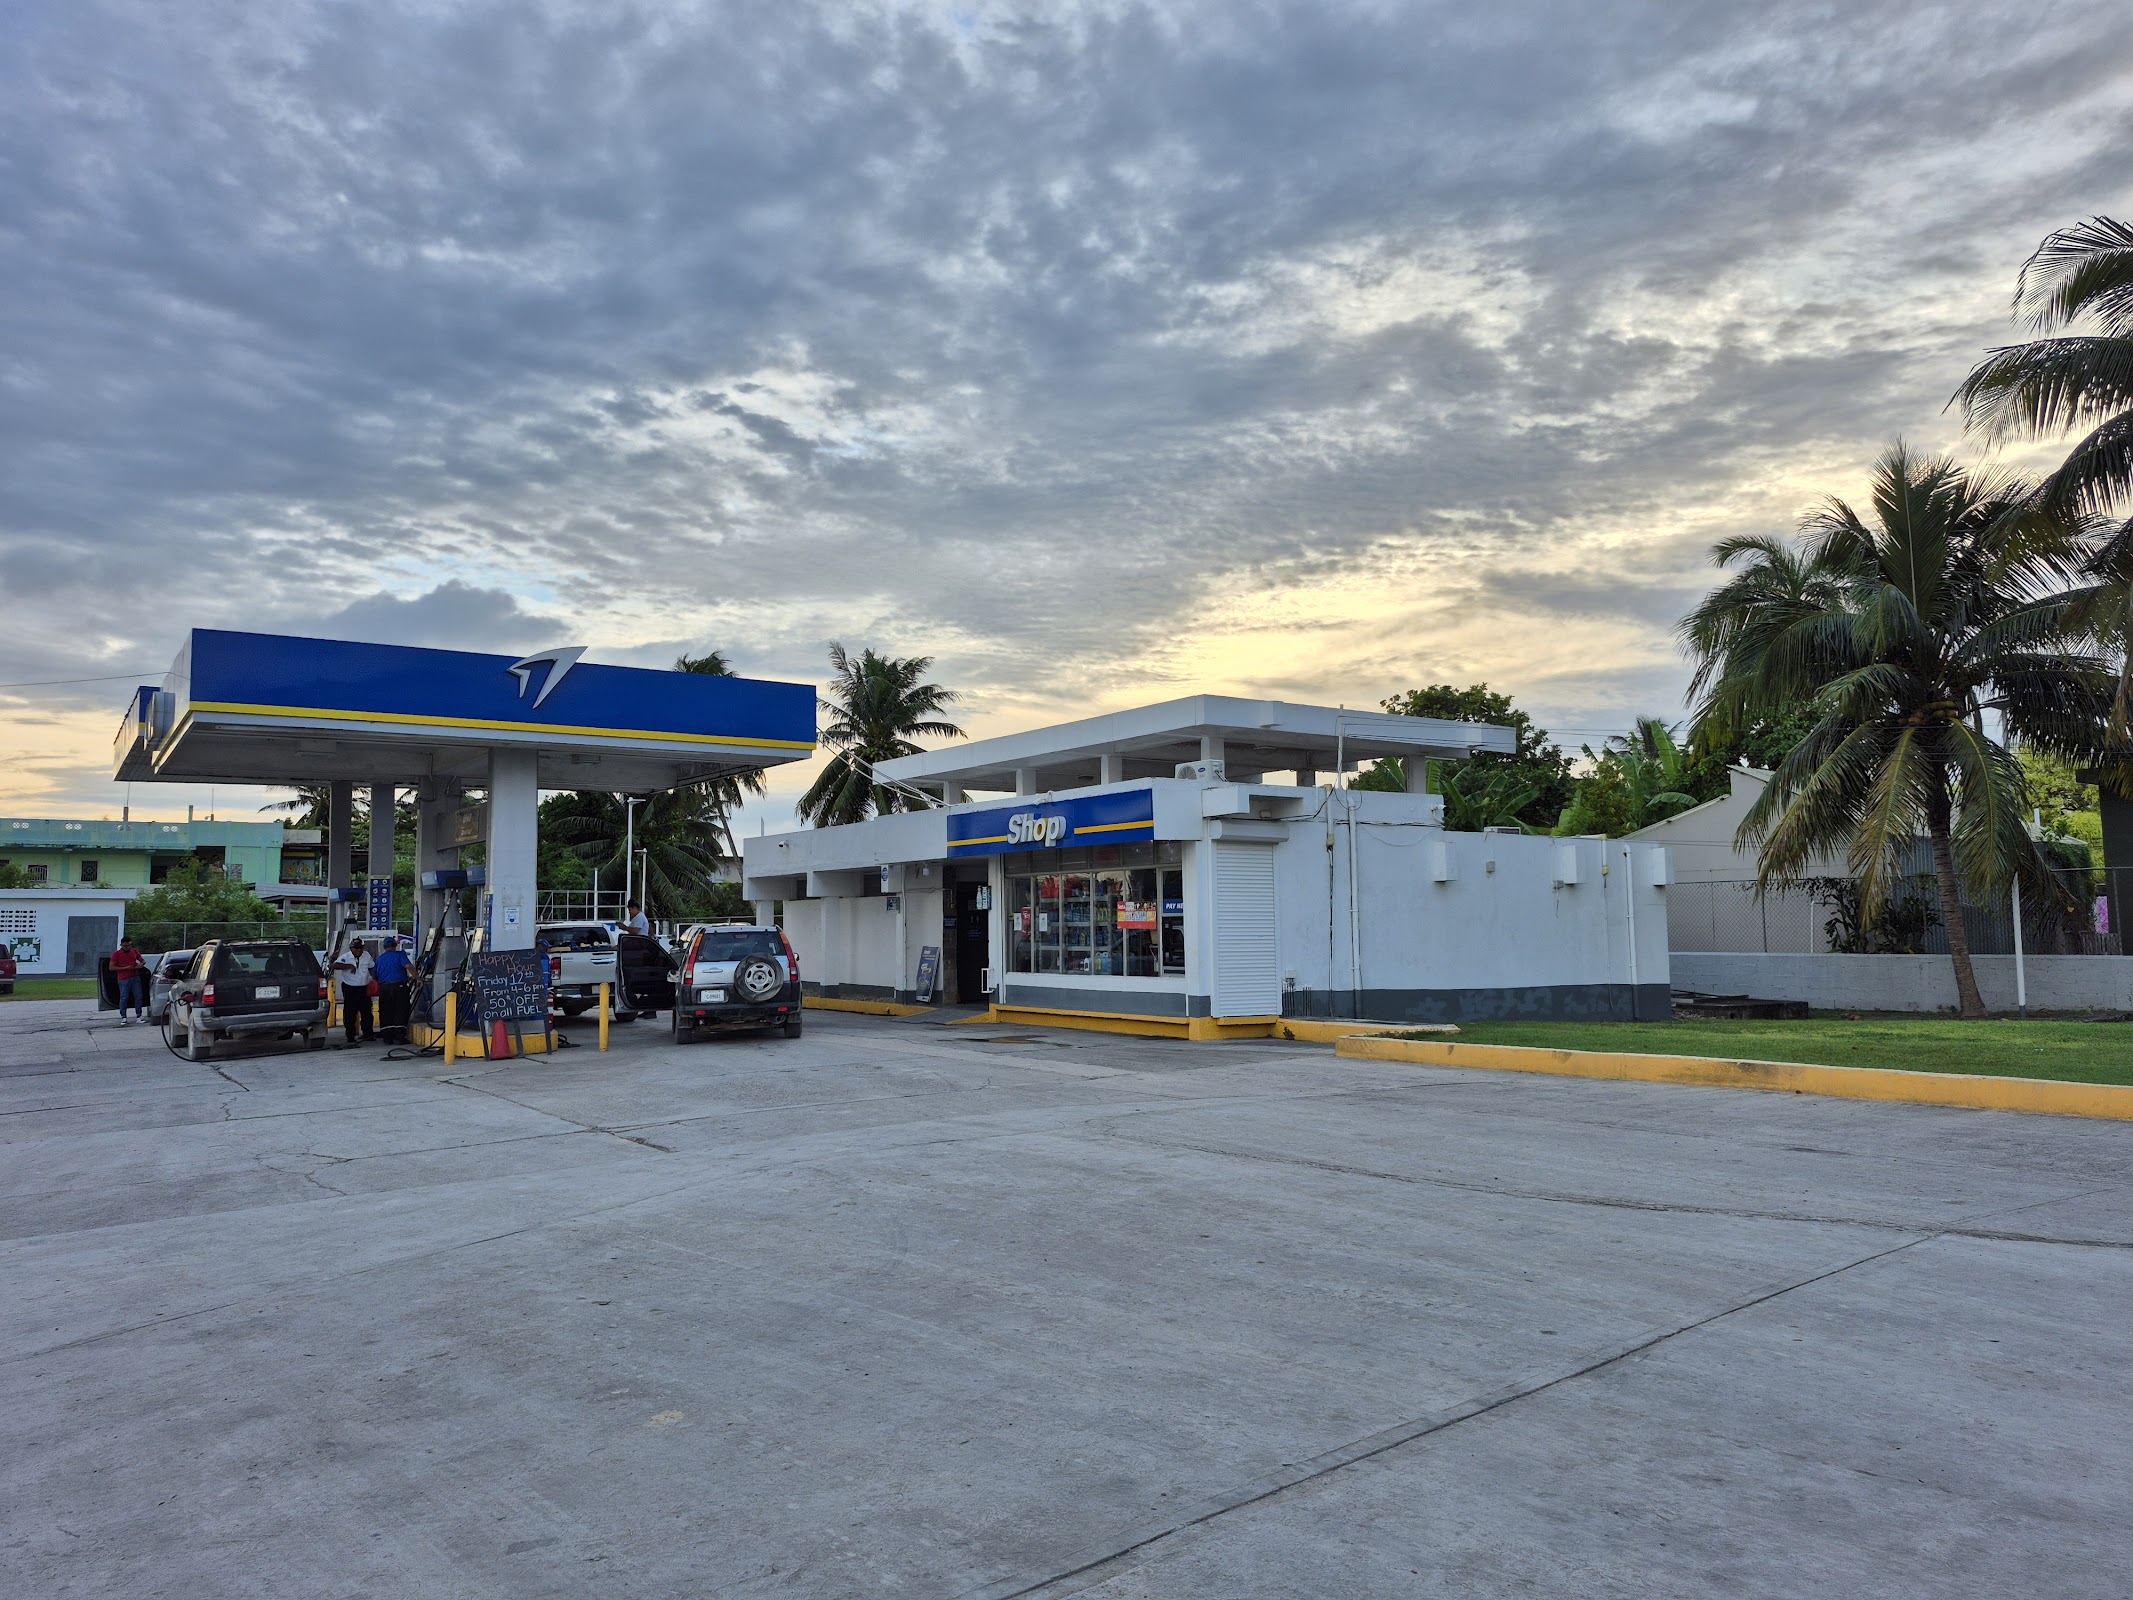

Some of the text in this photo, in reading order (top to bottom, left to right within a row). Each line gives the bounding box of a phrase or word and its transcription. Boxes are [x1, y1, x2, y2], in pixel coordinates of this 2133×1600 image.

[1007, 813, 1067, 847] Shop
[1165, 902, 1176, 910] PAY
[506, 963, 536, 974] Hour
[477, 971, 534, 987] Friday 12th
[483, 983, 544, 998] From 4-6 pm
[515, 993, 540, 1006] OFF
[500, 1007, 513, 1018] all
[516, 1005, 542, 1016] FUEL
